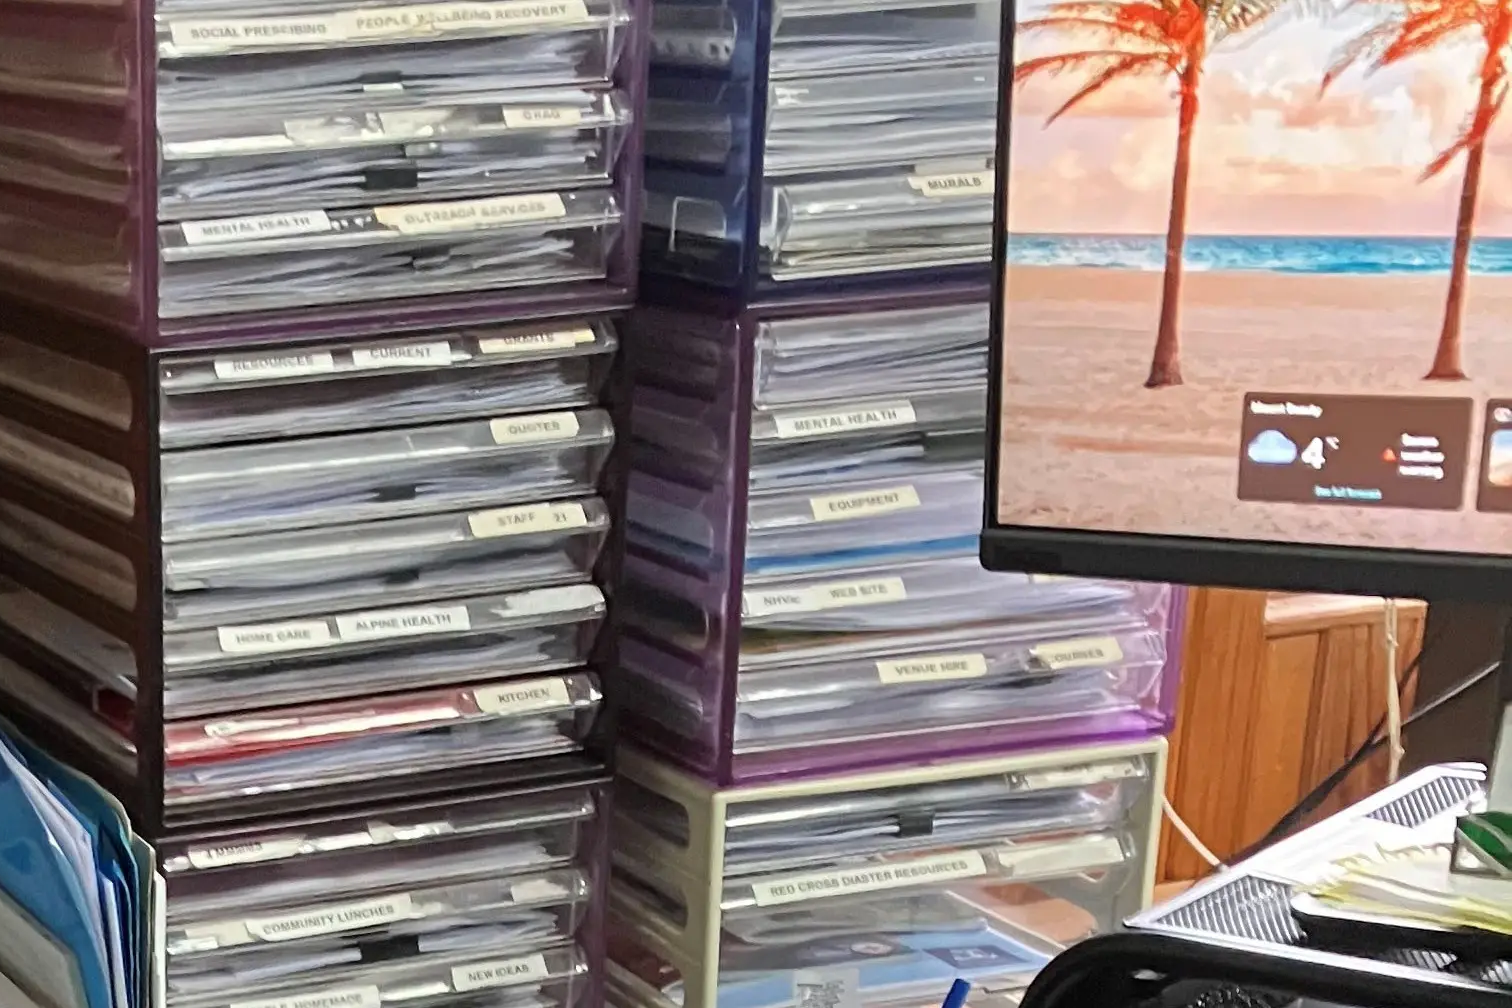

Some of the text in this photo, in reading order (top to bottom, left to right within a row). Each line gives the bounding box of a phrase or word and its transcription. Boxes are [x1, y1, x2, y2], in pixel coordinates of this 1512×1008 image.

[356, 15, 413, 30] PEOPLE
[495, 4, 567, 19] RECOVERY
[190, 27, 239, 40] SOCIAL
[201, 223, 255, 237] MENTAL
[369, 346, 433, 359] CURRENT
[794, 409, 898, 431] MENTAL HEALTH
[828, 492, 900, 512] EQUIPMENT
[355, 612, 453, 631] ALPINE HEALTH
[235, 629, 312, 645] HOME CARE
[894, 662, 938, 676] VENUE
[497, 687, 551, 703] KITCHEN
[770, 884, 795, 898] RED
[798, 878, 840, 893] CROSS
[895, 860, 969, 879] RESOURCES
[261, 904, 395, 936] COMMUNITY LUNCHES
[468, 964, 530, 982] NEW IDEAS
